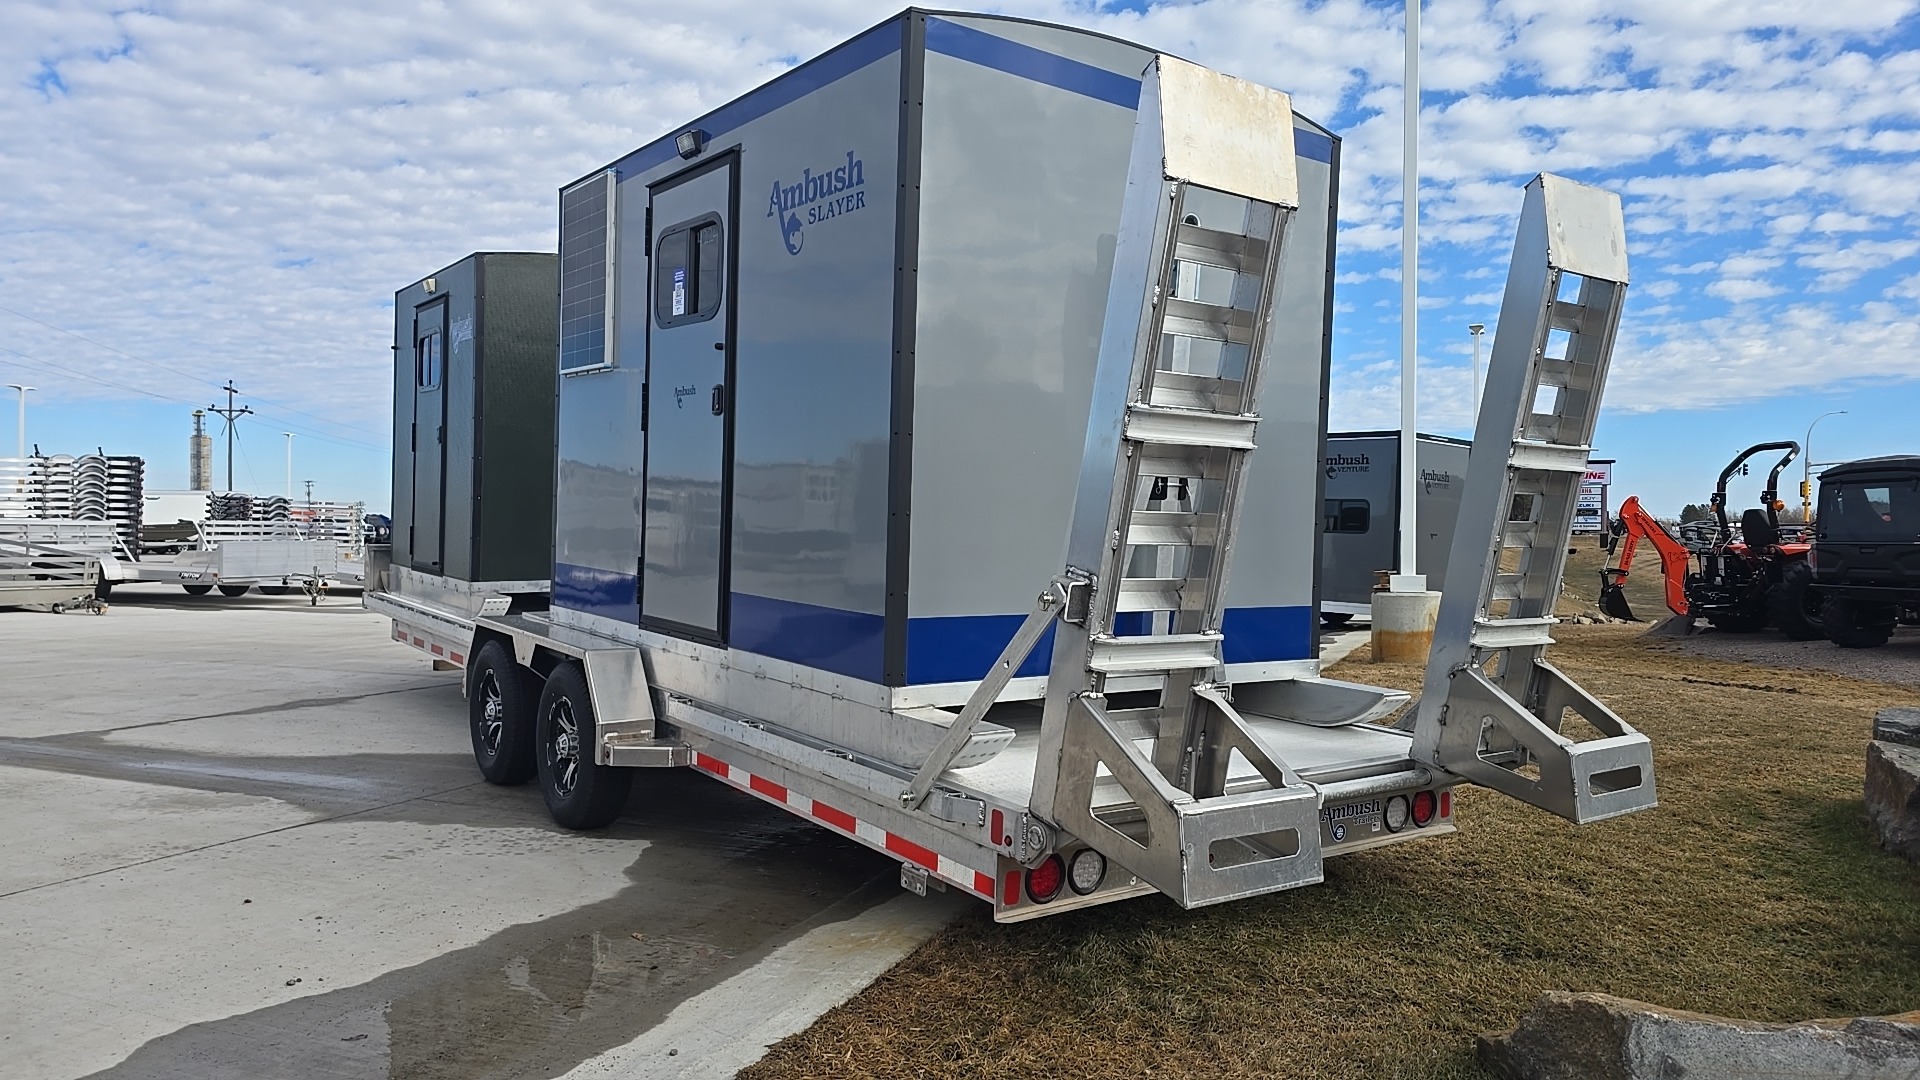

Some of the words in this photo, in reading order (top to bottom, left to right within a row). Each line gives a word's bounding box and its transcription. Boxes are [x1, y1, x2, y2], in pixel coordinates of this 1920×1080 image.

[767, 150, 864, 218] Ambush
[808, 191, 865, 225] SLAYER
[674, 384, 696, 397] Ambush
[1326, 454, 1370, 466] mbush
[1420, 468, 1450, 483] Ambush
[1321, 799, 1381, 822] Ambush
